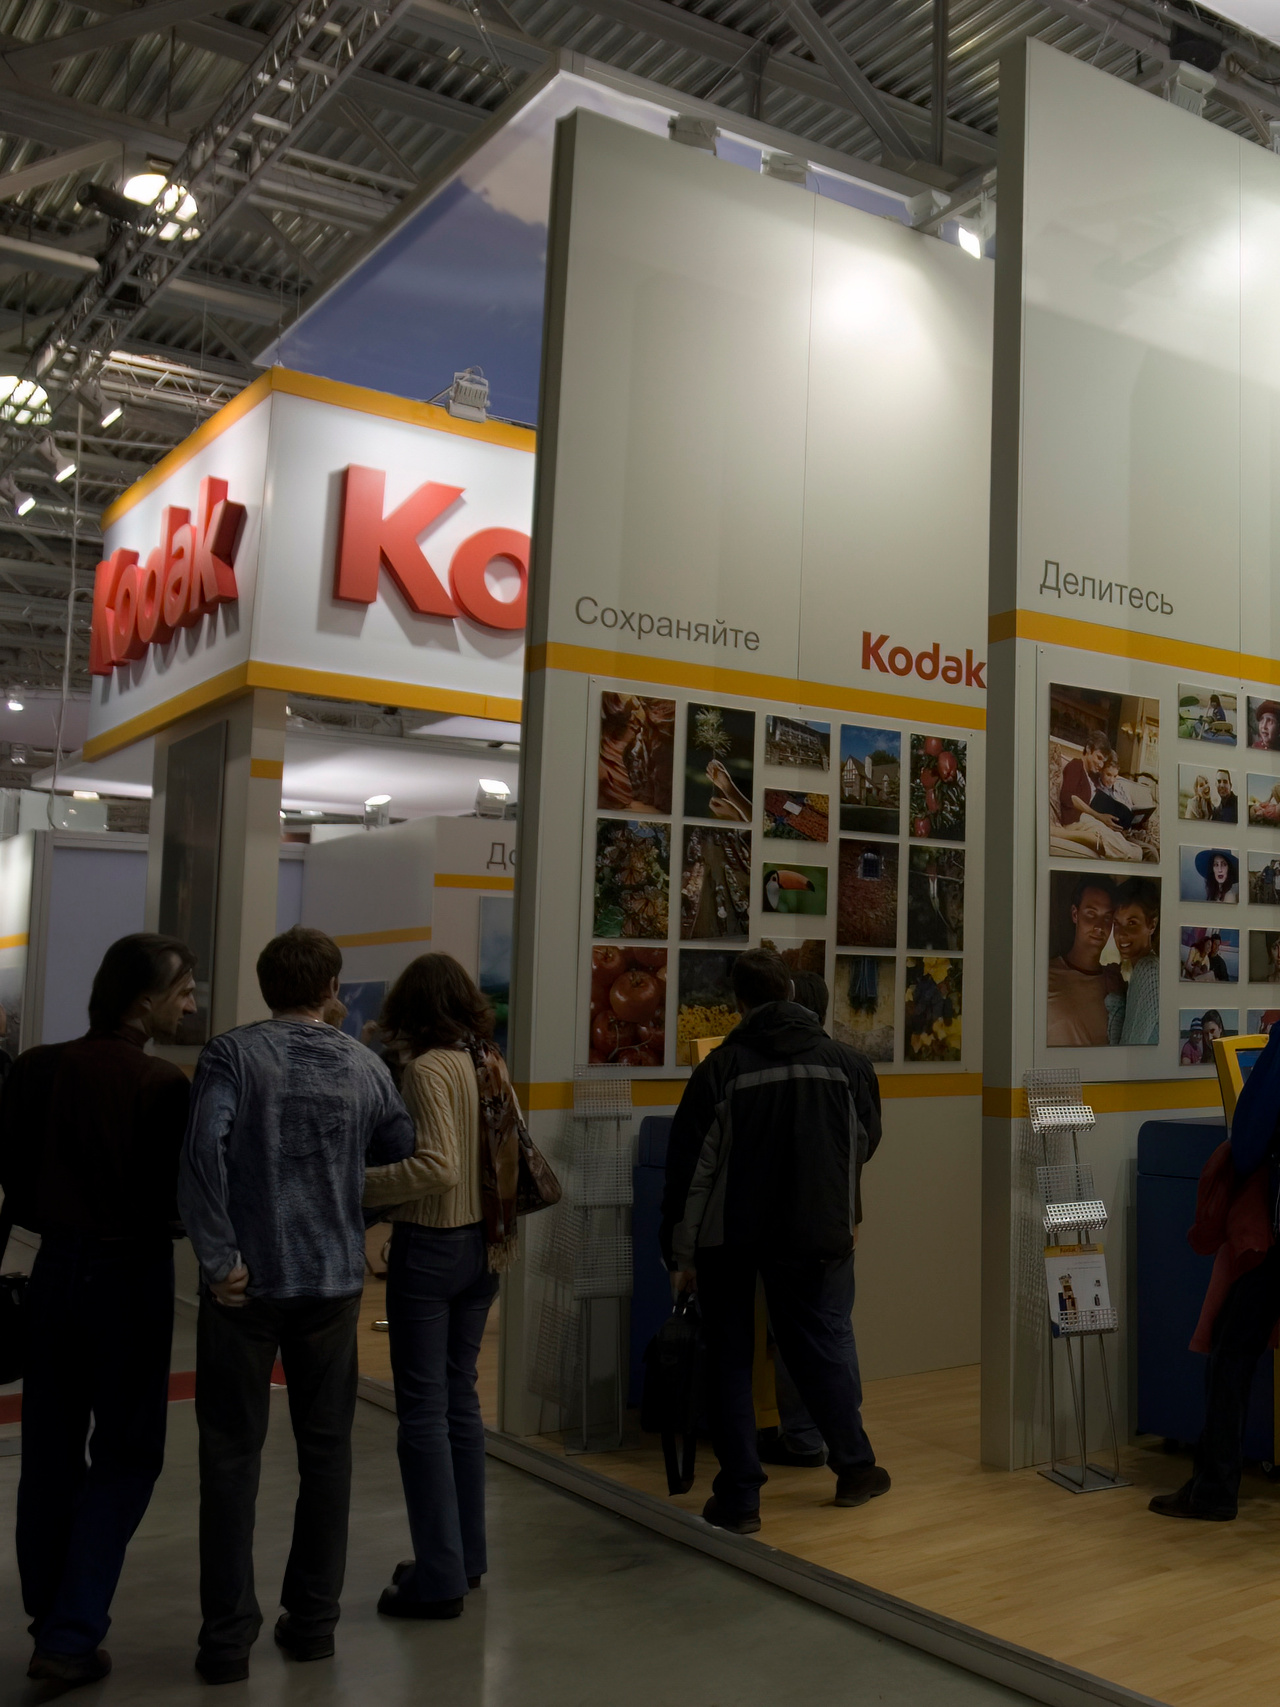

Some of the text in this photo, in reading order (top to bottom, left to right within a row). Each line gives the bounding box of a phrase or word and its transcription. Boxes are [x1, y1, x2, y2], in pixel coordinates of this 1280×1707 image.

[88, 474, 247, 676] Kodak
[1040, 560, 1174, 615] Делитесь
[575, 596, 760, 651] Сохраняйте
[861, 630, 987, 689] Kodak
